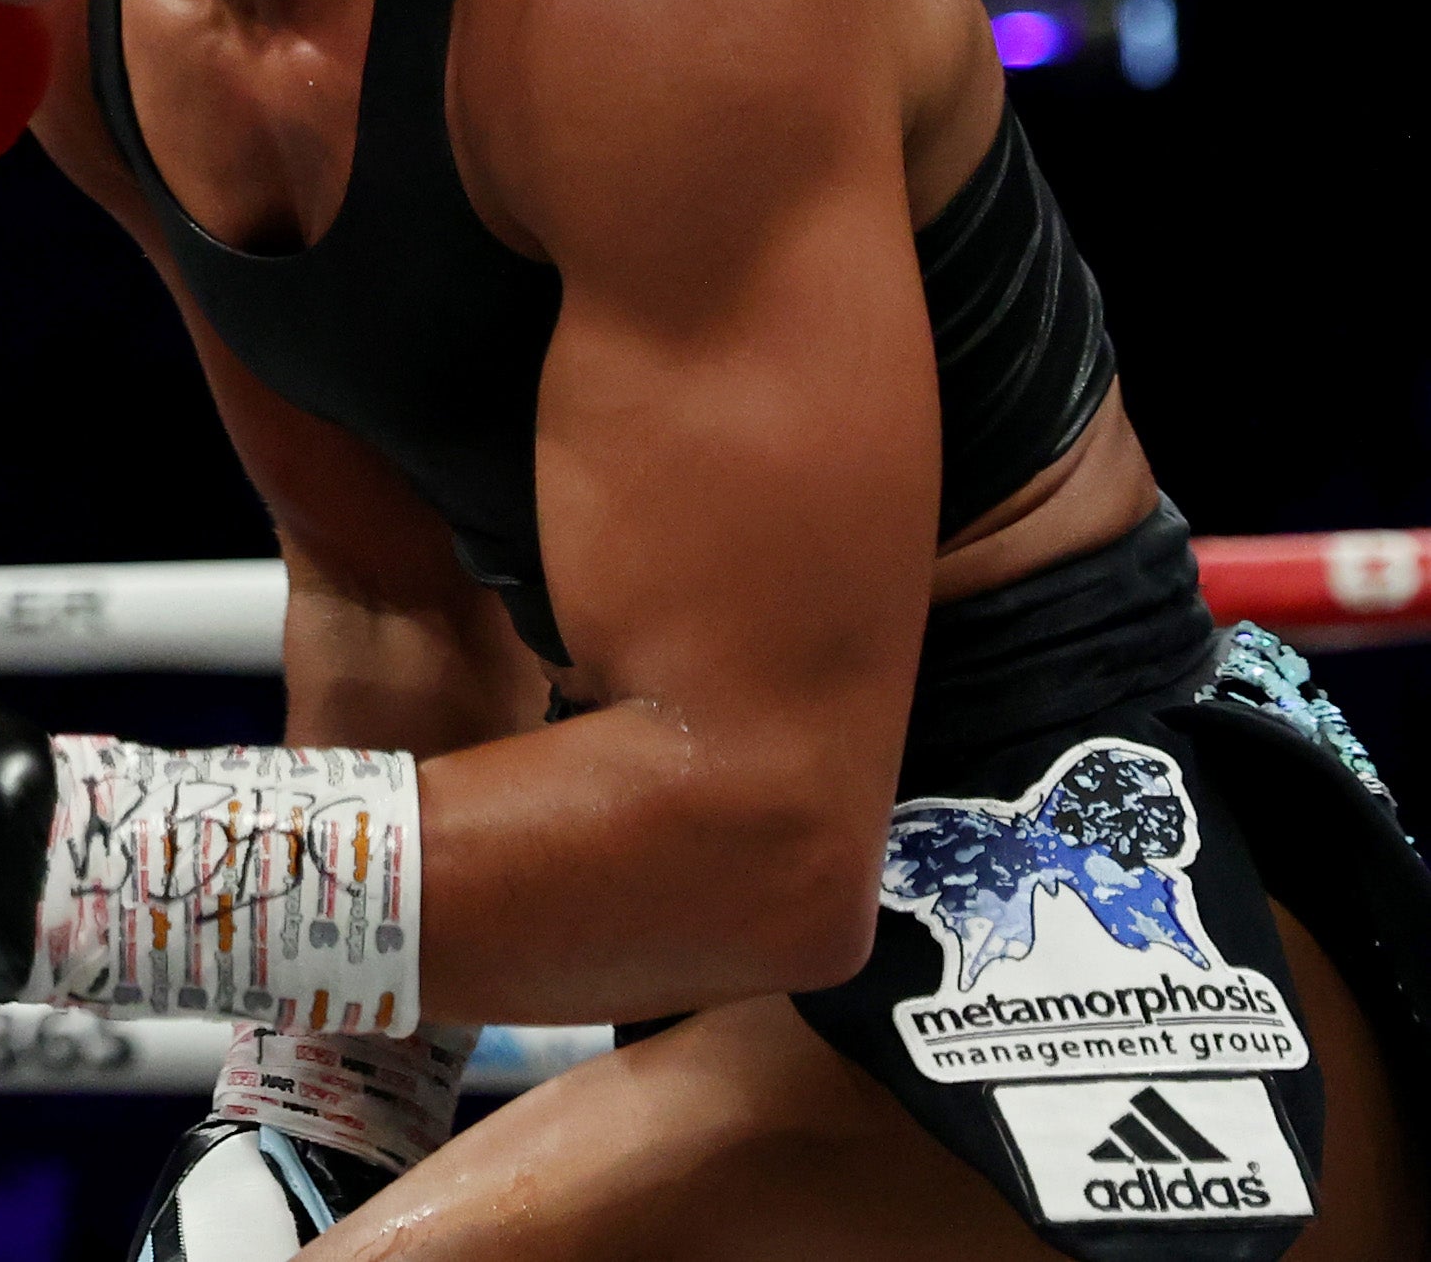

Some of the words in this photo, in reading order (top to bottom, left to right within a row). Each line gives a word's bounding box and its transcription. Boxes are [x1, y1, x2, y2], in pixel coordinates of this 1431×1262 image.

[909, 973, 1278, 1037] metamorphosis
[933, 1029, 1179, 1069] management
[1190, 1030, 1293, 1061] group
[1083, 1168, 1271, 1213] adidas
